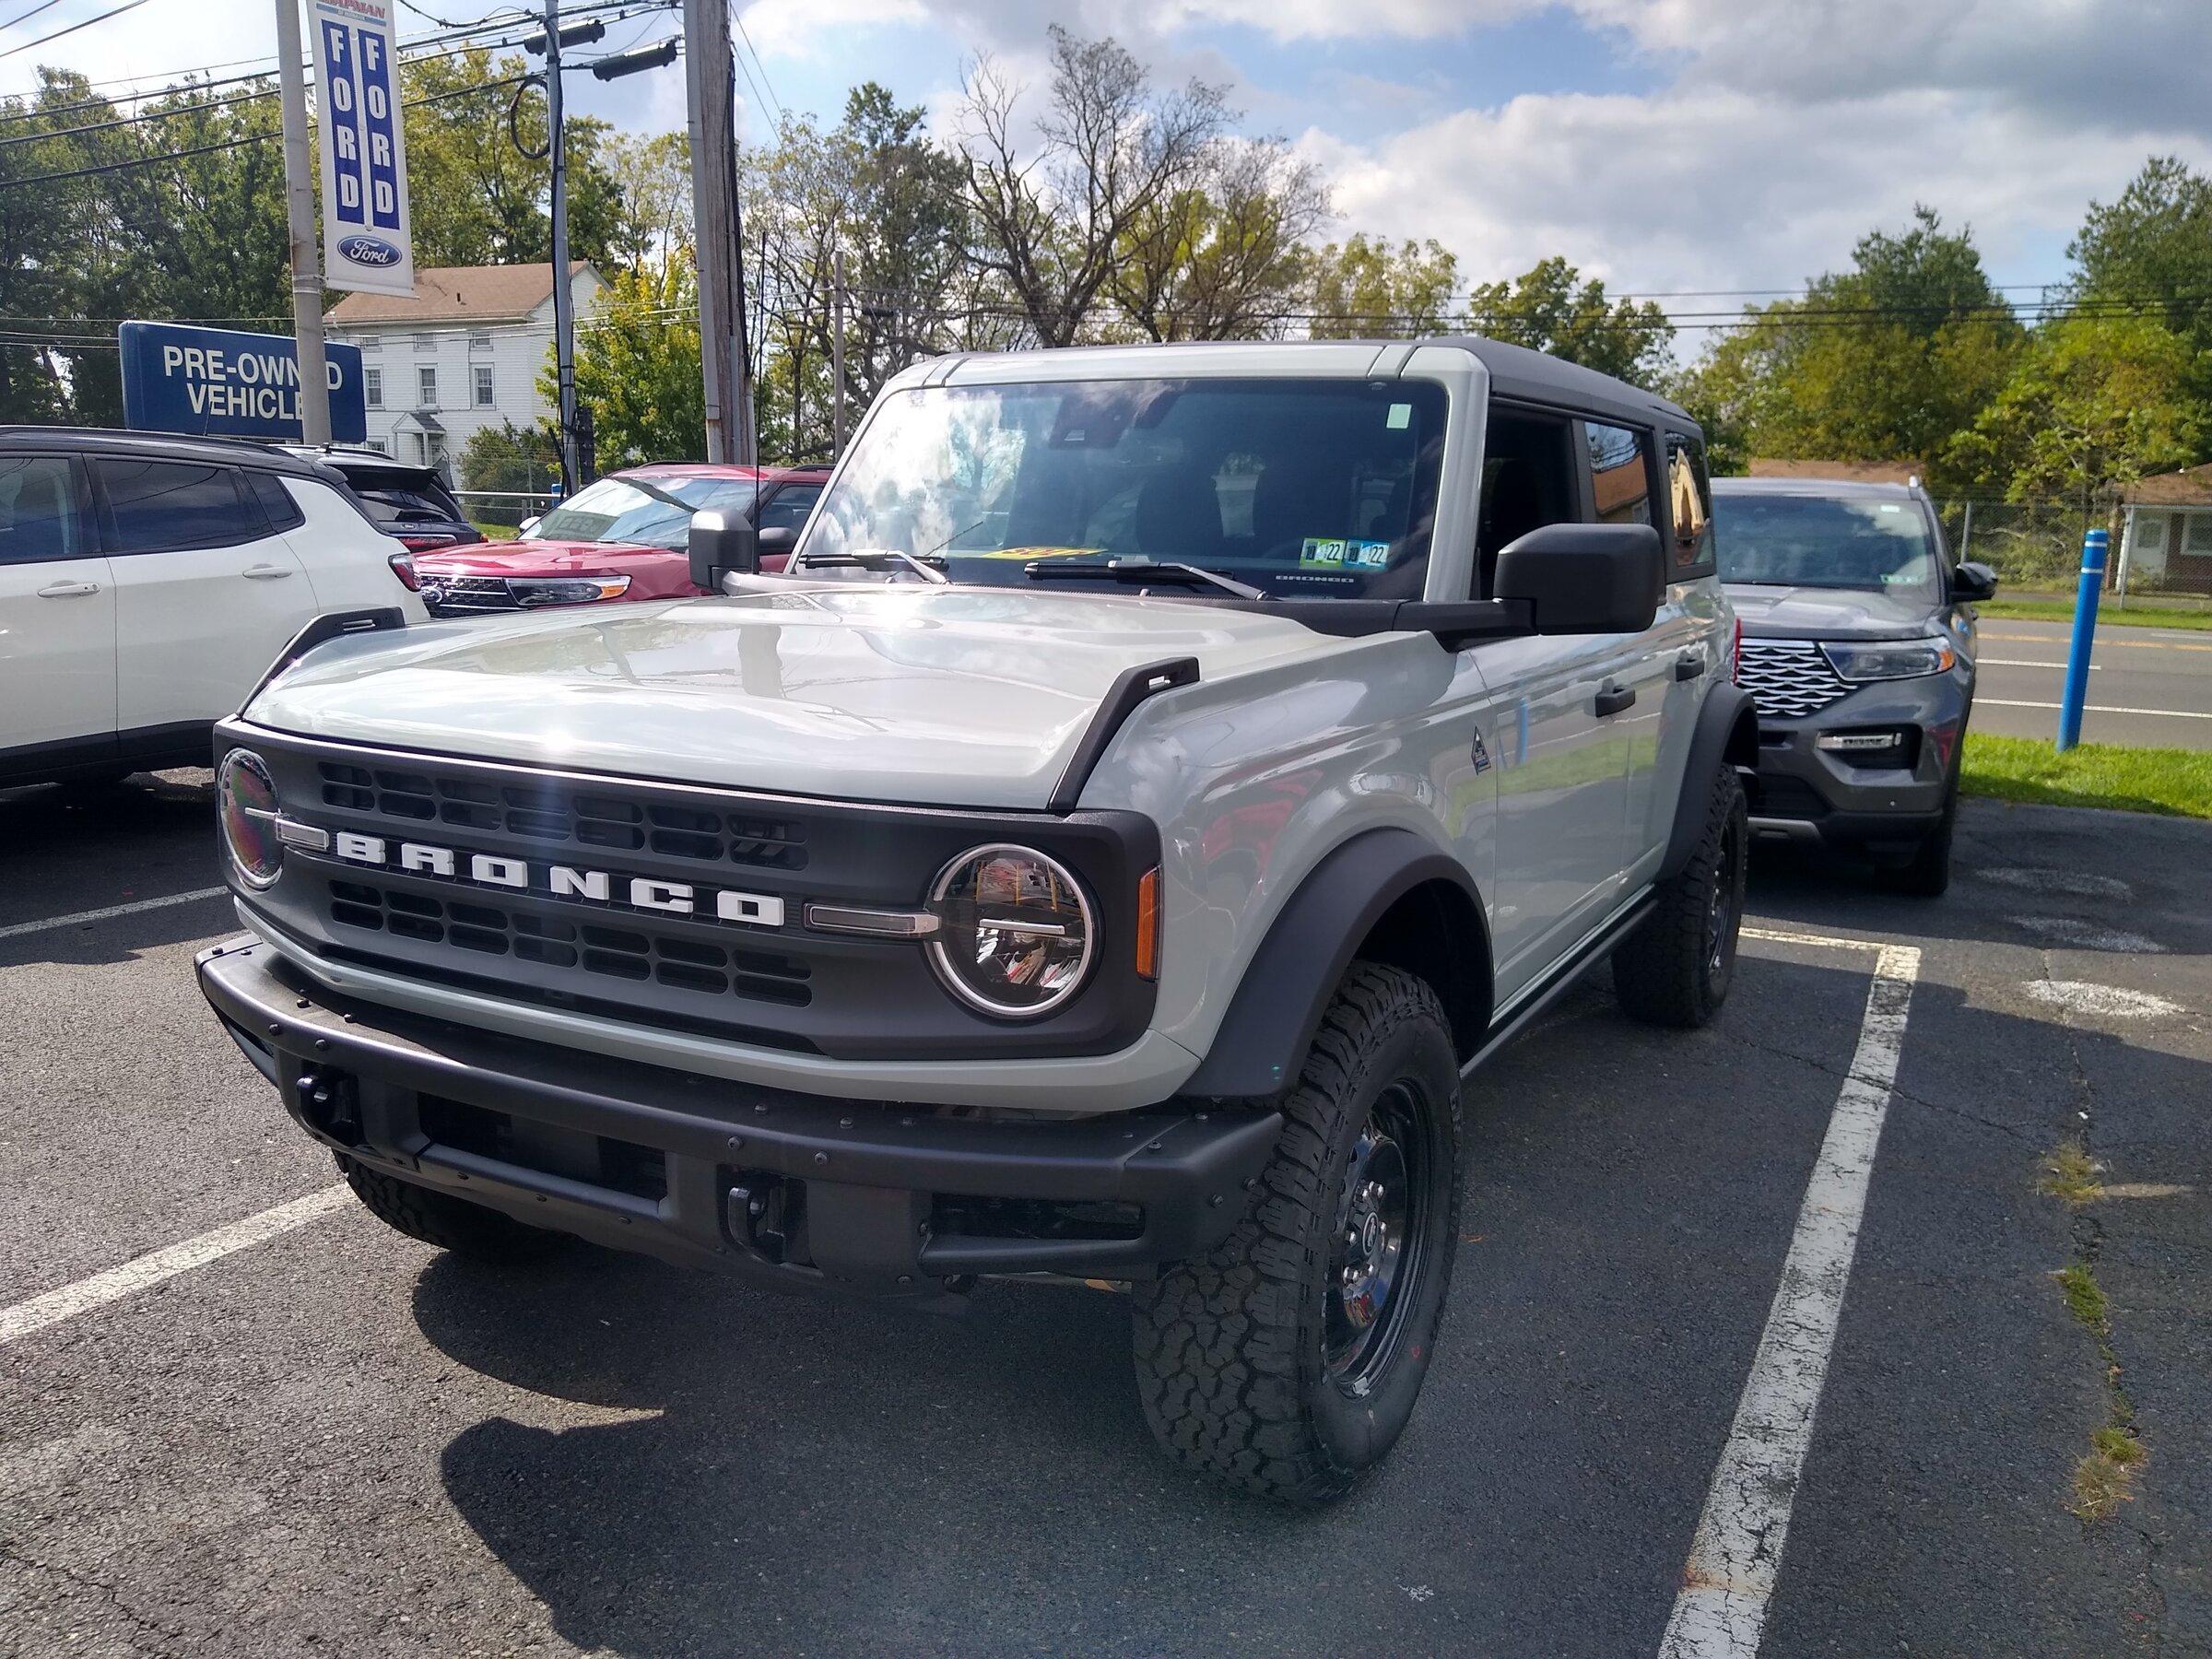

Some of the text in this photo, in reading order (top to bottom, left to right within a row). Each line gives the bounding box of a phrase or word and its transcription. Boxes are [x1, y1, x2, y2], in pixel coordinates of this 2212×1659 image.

[330, 29, 359, 208] FORD
[365, 37, 394, 214] FORD
[350, 240, 390, 264] Ford
[163, 346, 343, 391] PRE-OWND
[1326, 543, 1341, 561] 22
[1370, 546, 1384, 563] 22
[336, 830, 784, 926] BRONCO
